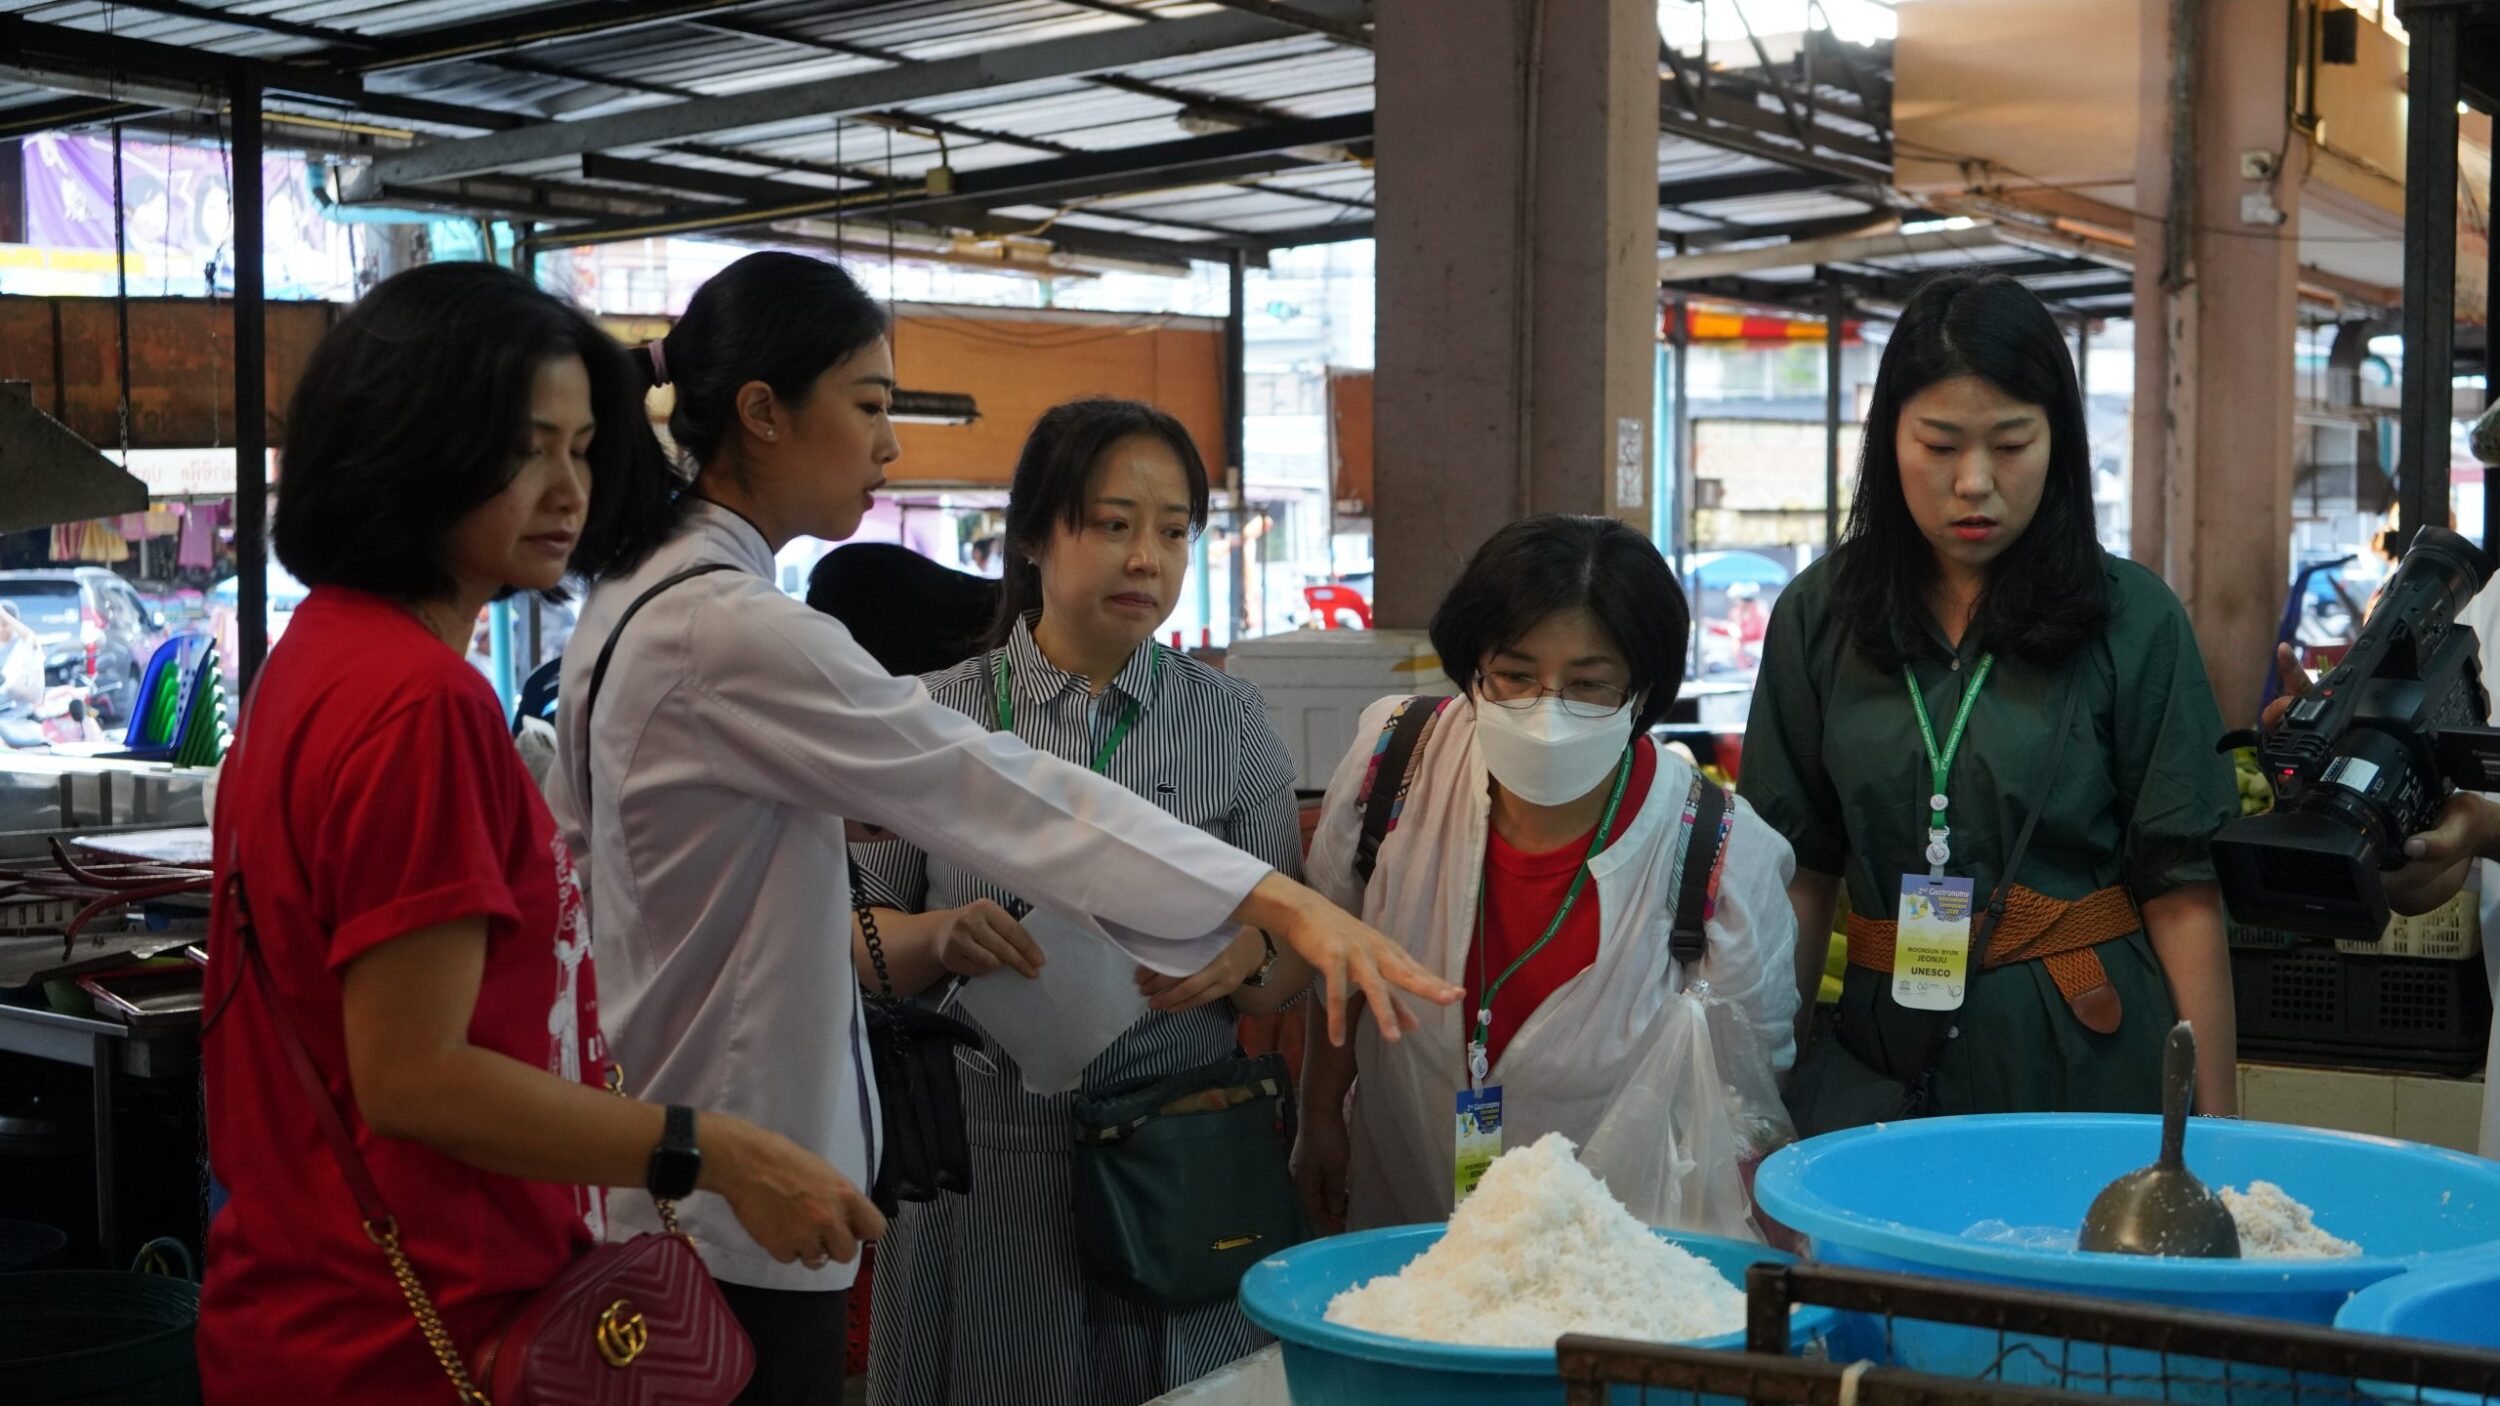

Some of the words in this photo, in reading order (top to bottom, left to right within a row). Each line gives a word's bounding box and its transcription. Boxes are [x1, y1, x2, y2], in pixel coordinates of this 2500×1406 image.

[1943, 730, 1960, 762] Gastronomy
[1955, 695, 1973, 730] International
[1929, 888, 1969, 898] Gastronomy
[1917, 955, 1947, 964] JEONJU
[1911, 966, 1951, 978] UNESCO
